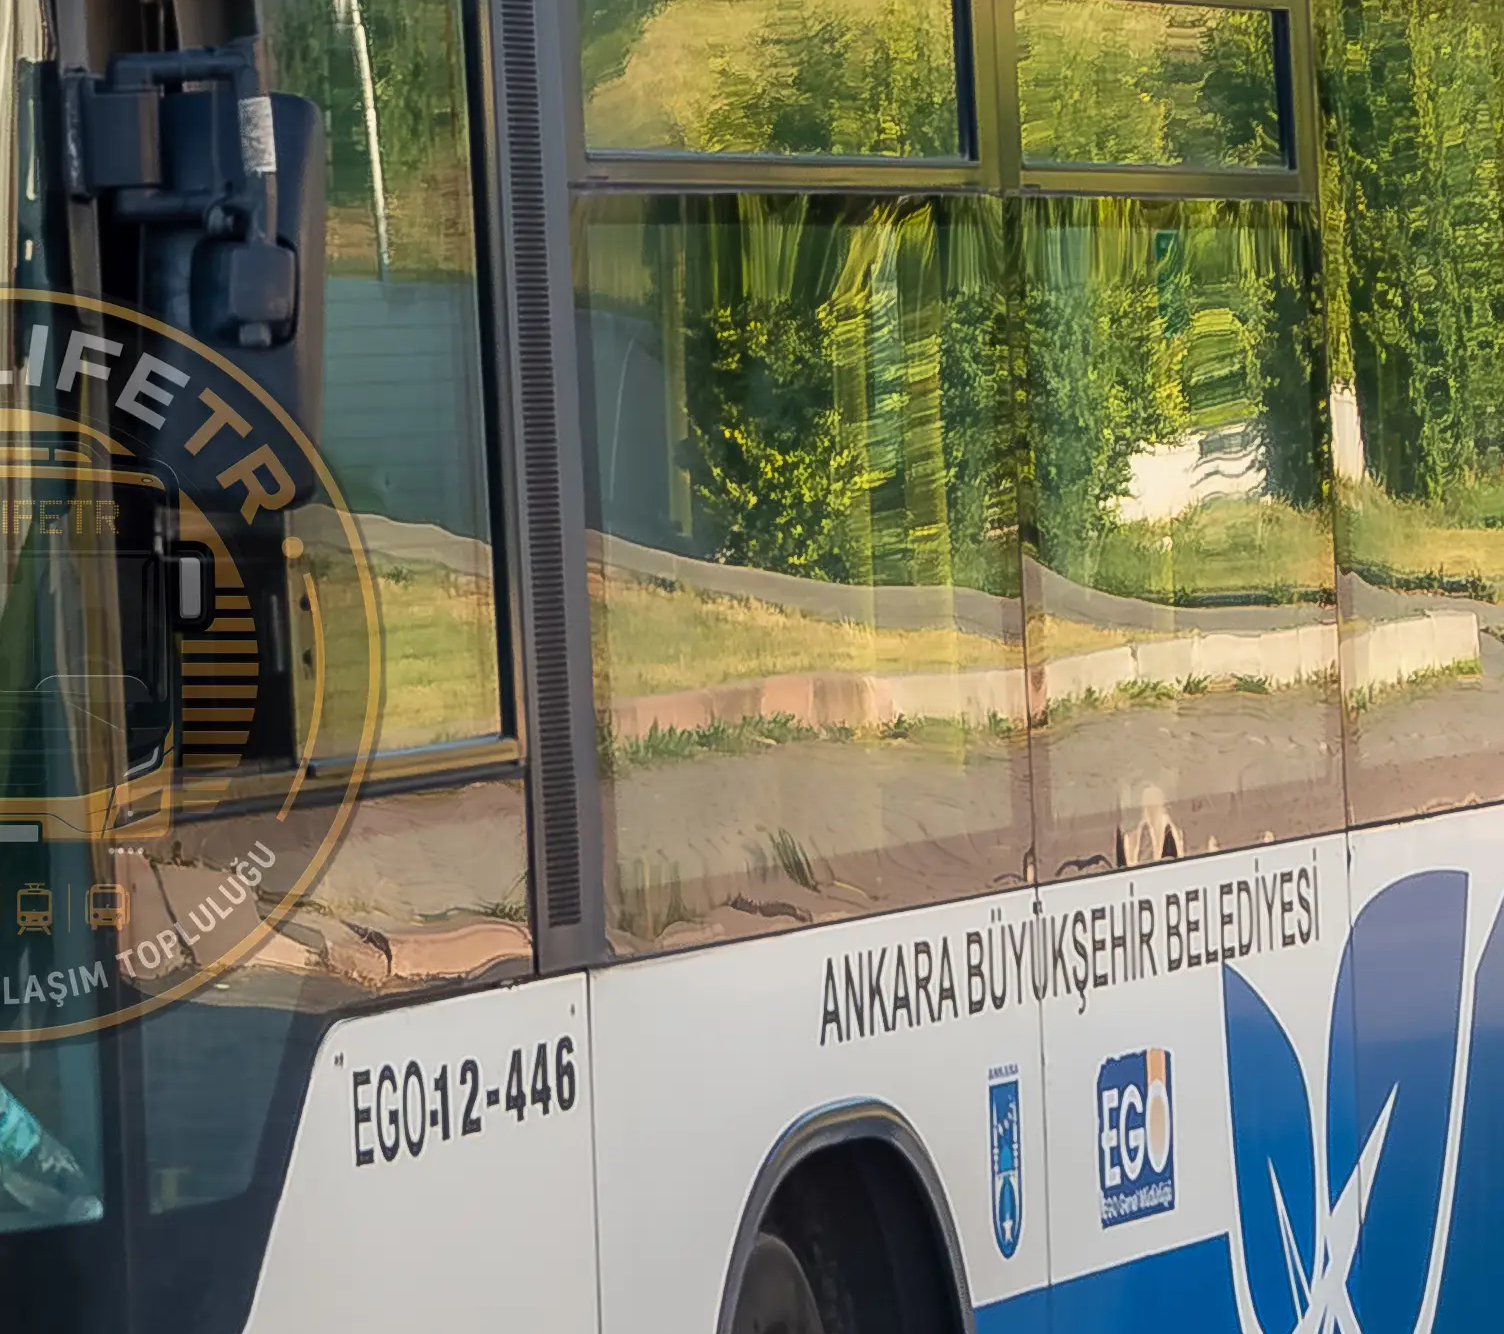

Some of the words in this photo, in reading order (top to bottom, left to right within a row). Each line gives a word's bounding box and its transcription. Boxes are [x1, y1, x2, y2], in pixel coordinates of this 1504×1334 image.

[819, 936, 960, 1046] ANKARA
[966, 882, 1157, 1015] BÜYÜKŞEHİR
[1166, 847, 1321, 972] BELEDİYESİ
[1101, 1081, 1171, 1189] EGO
